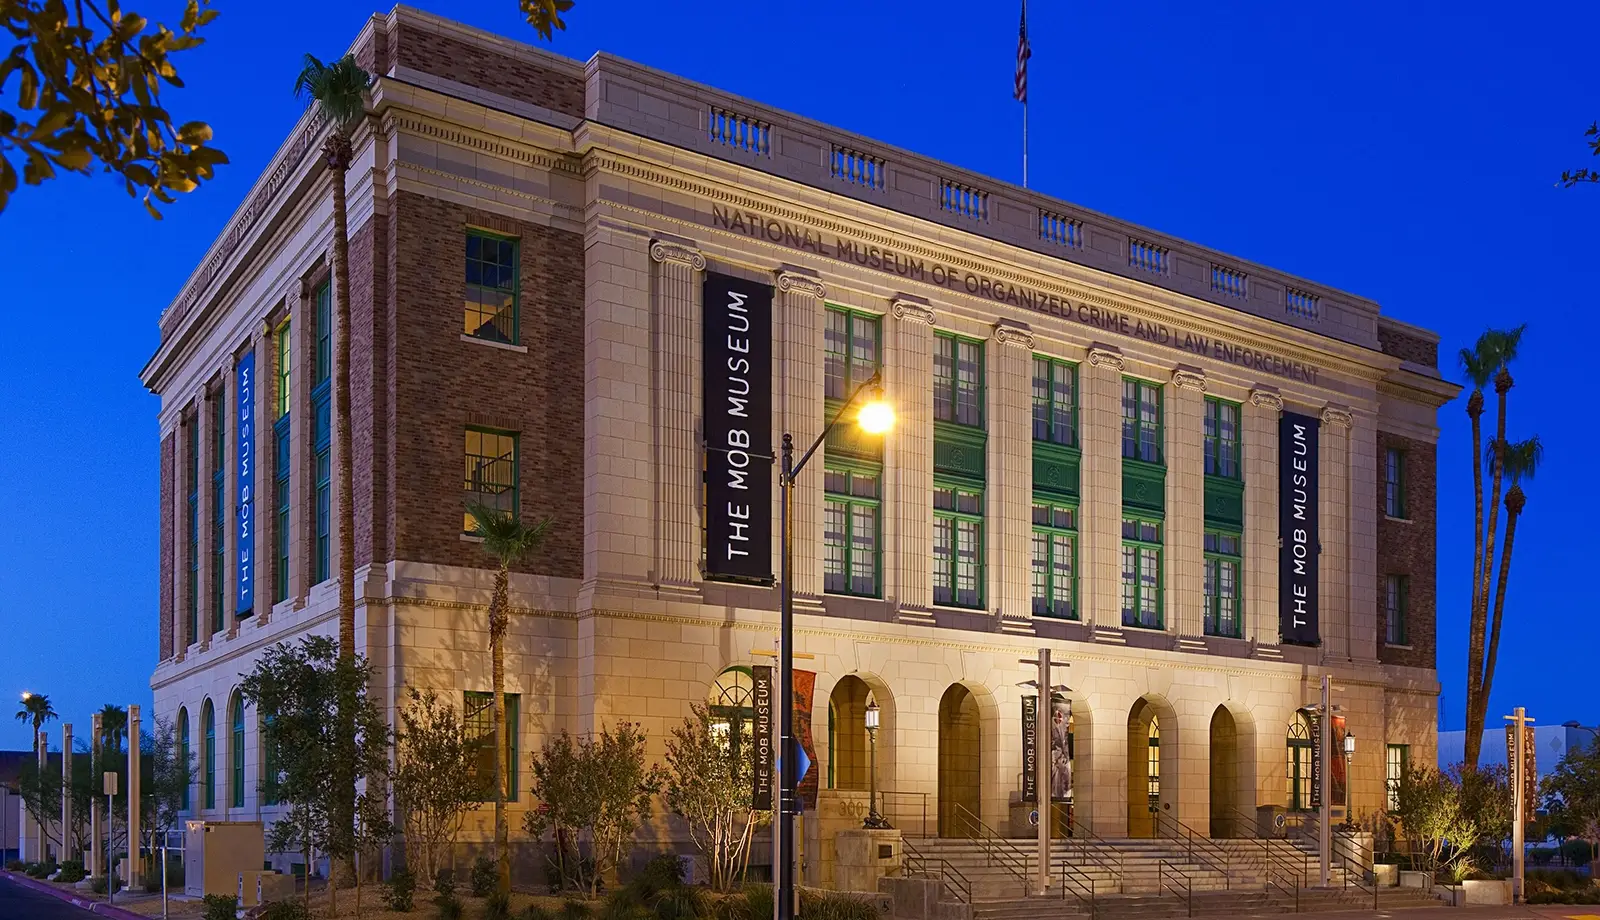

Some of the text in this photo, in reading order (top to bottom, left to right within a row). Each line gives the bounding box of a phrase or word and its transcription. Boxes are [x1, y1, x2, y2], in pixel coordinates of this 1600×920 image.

[712, 205, 1319, 386] NATIONAL MUSEUM OF ORGANIZED CRIME AND LAW ENFORCEMENT
[241, 367, 251, 601] THE MOB MUSEUM
[727, 290, 750, 561] THE MOB MUSEUM
[1293, 423, 1307, 629] THE MOB MUSEUM
[758, 679, 769, 795] THE MOB MUSEUM
[839, 801, 863, 817] 300
[1026, 698, 1035, 797] THE MOB MUSEUM
